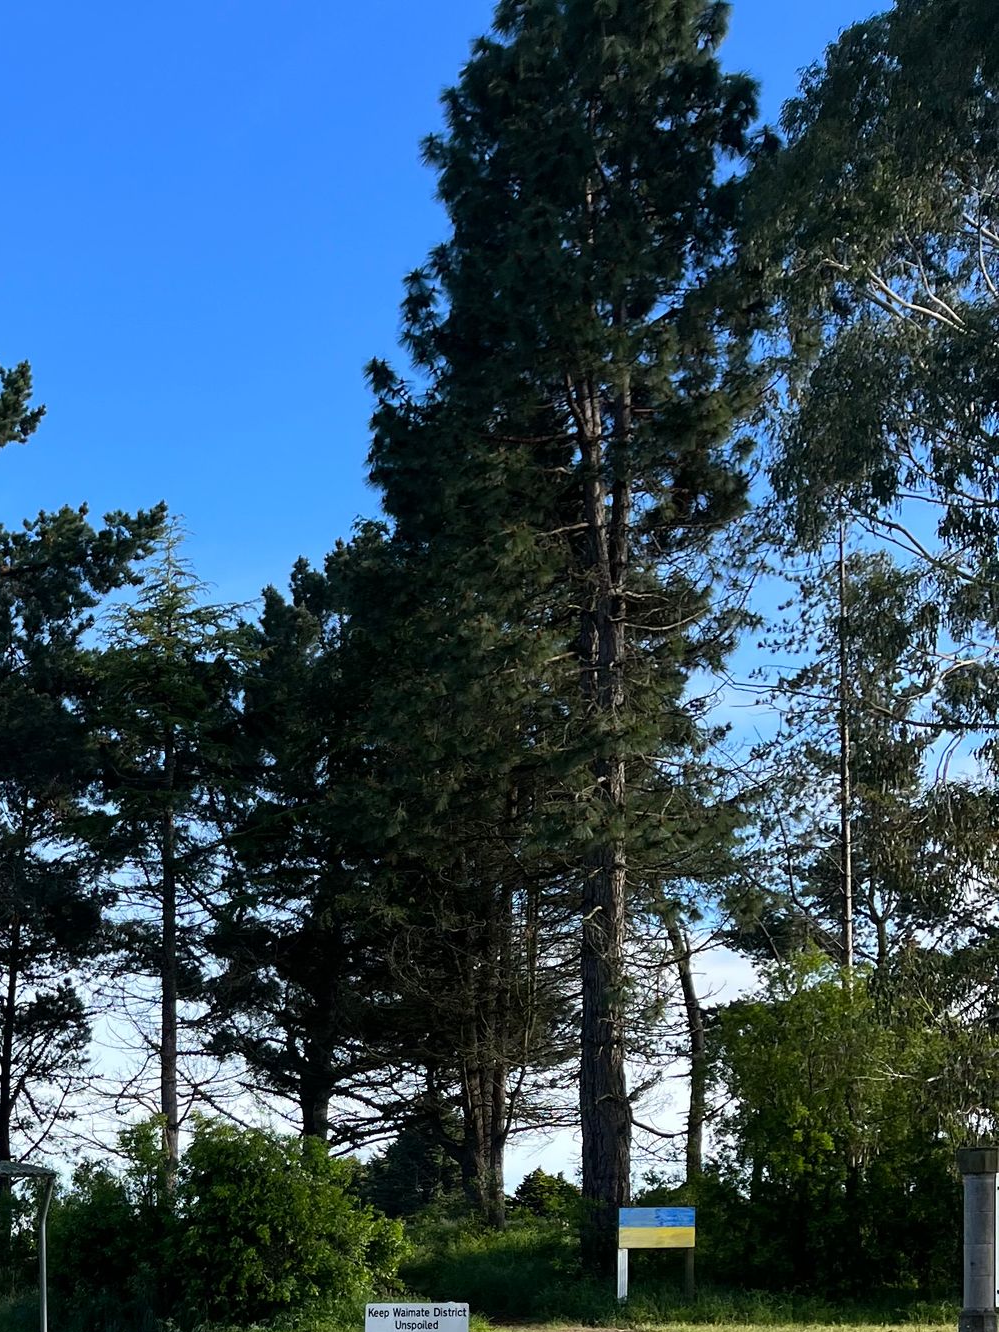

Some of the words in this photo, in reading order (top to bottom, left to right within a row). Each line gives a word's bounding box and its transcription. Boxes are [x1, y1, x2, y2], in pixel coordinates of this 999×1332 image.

[368, 1308, 389, 1319] Keep
[393, 1308, 430, 1318] Waimate
[433, 1307, 467, 1317] District
[395, 1320, 439, 1331] Unspoiled
